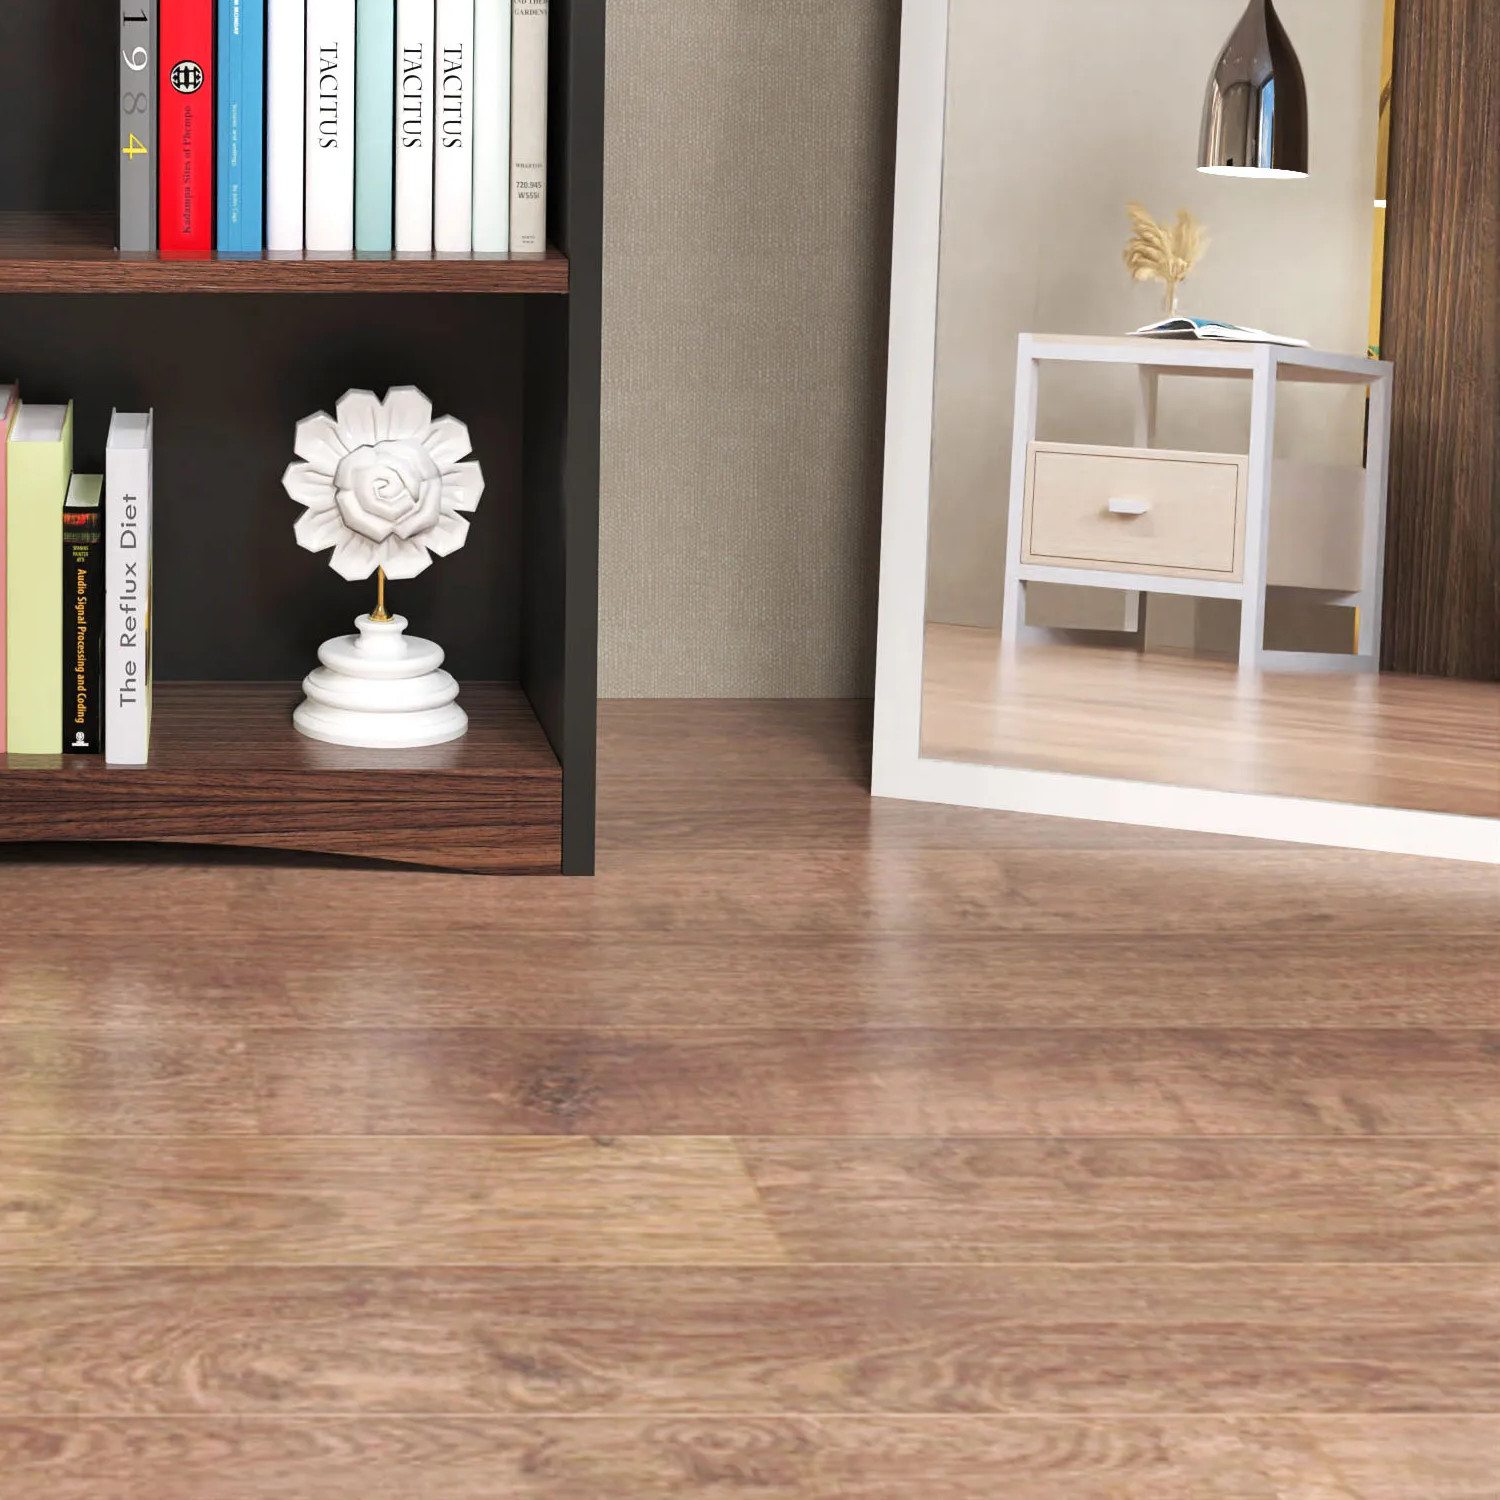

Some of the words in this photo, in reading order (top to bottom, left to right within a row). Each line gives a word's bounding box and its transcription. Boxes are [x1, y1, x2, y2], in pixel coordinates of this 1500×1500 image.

[318, 42, 338, 148] TACITUS
[403, 43, 422, 147] TACITUS
[443, 43, 463, 148] TACITUS
[182, 149, 190, 158] of
[121, 494, 136, 548] Diet
[77, 569, 87, 594] Audio
[120, 562, 136, 647] Reflux
[75, 597, 87, 624] Signal
[75, 626, 87, 672] Processing
[77, 674, 87, 691] and
[120, 661, 136, 707] The
[75, 693, 86, 723] Coding
